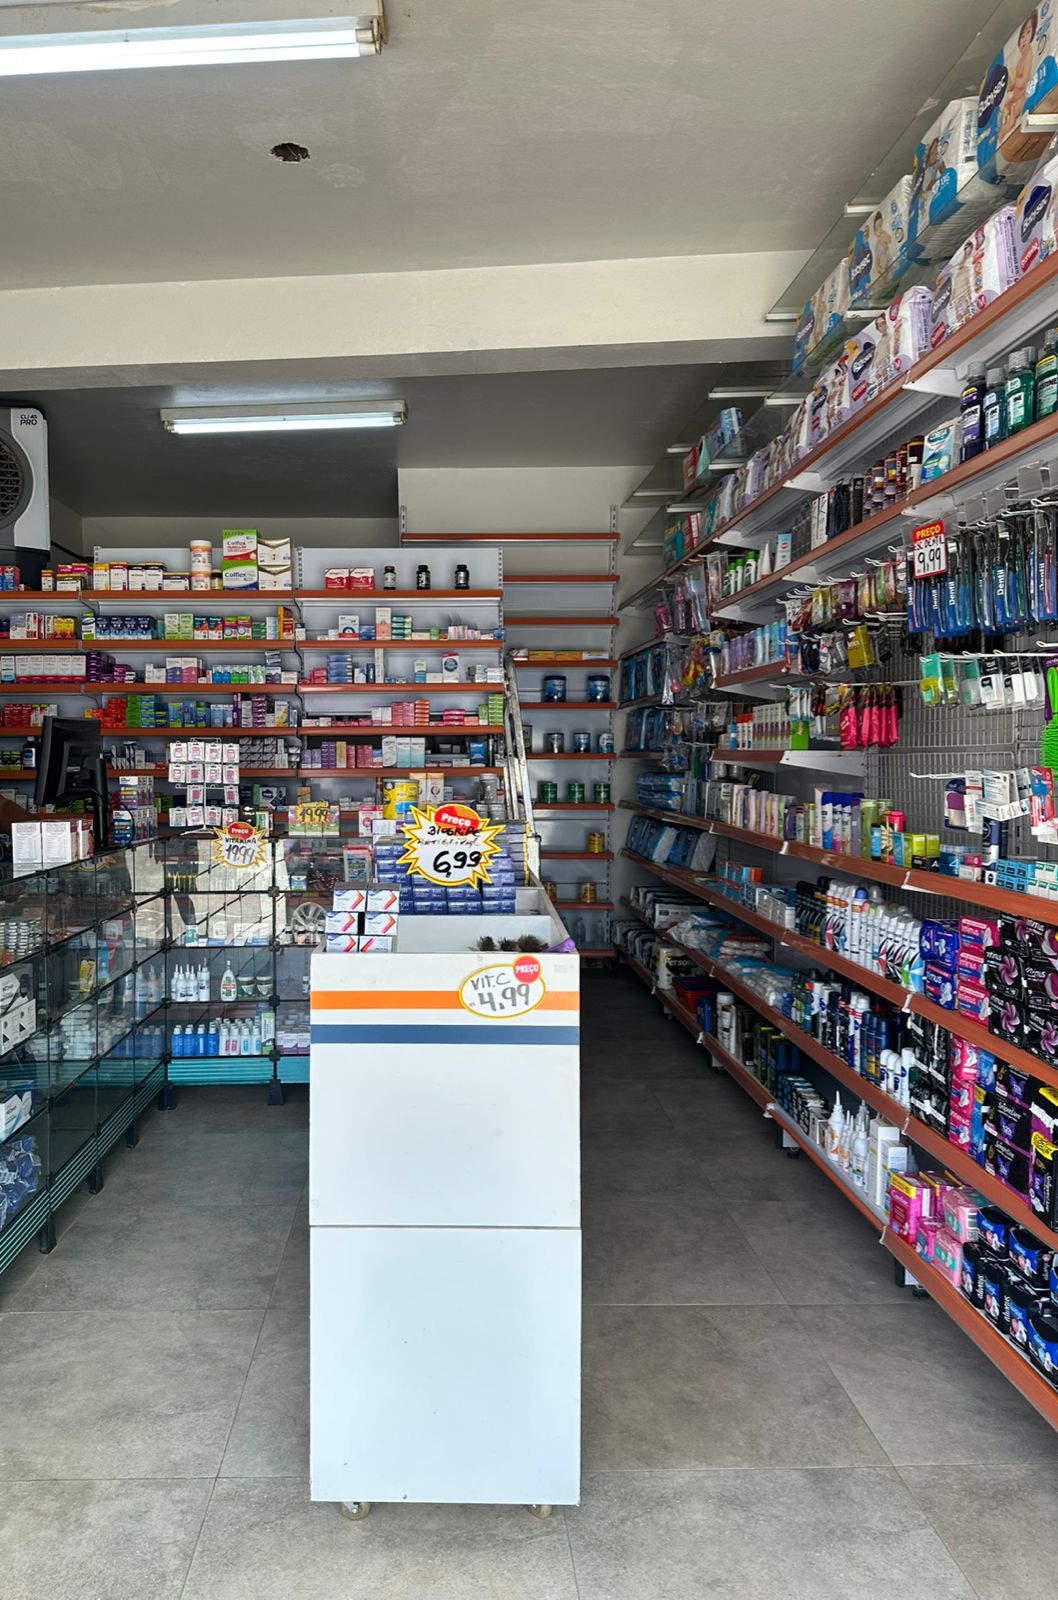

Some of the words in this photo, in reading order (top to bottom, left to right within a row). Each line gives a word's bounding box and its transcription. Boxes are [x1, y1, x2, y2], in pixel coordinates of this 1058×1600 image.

[915, 524, 941, 540] PREÇO
[997, 569, 1005, 596] Dentil
[440, 812, 472, 828] Preço
[231, 827, 250, 835] Preço
[515, 964, 539, 975] PREÇO
